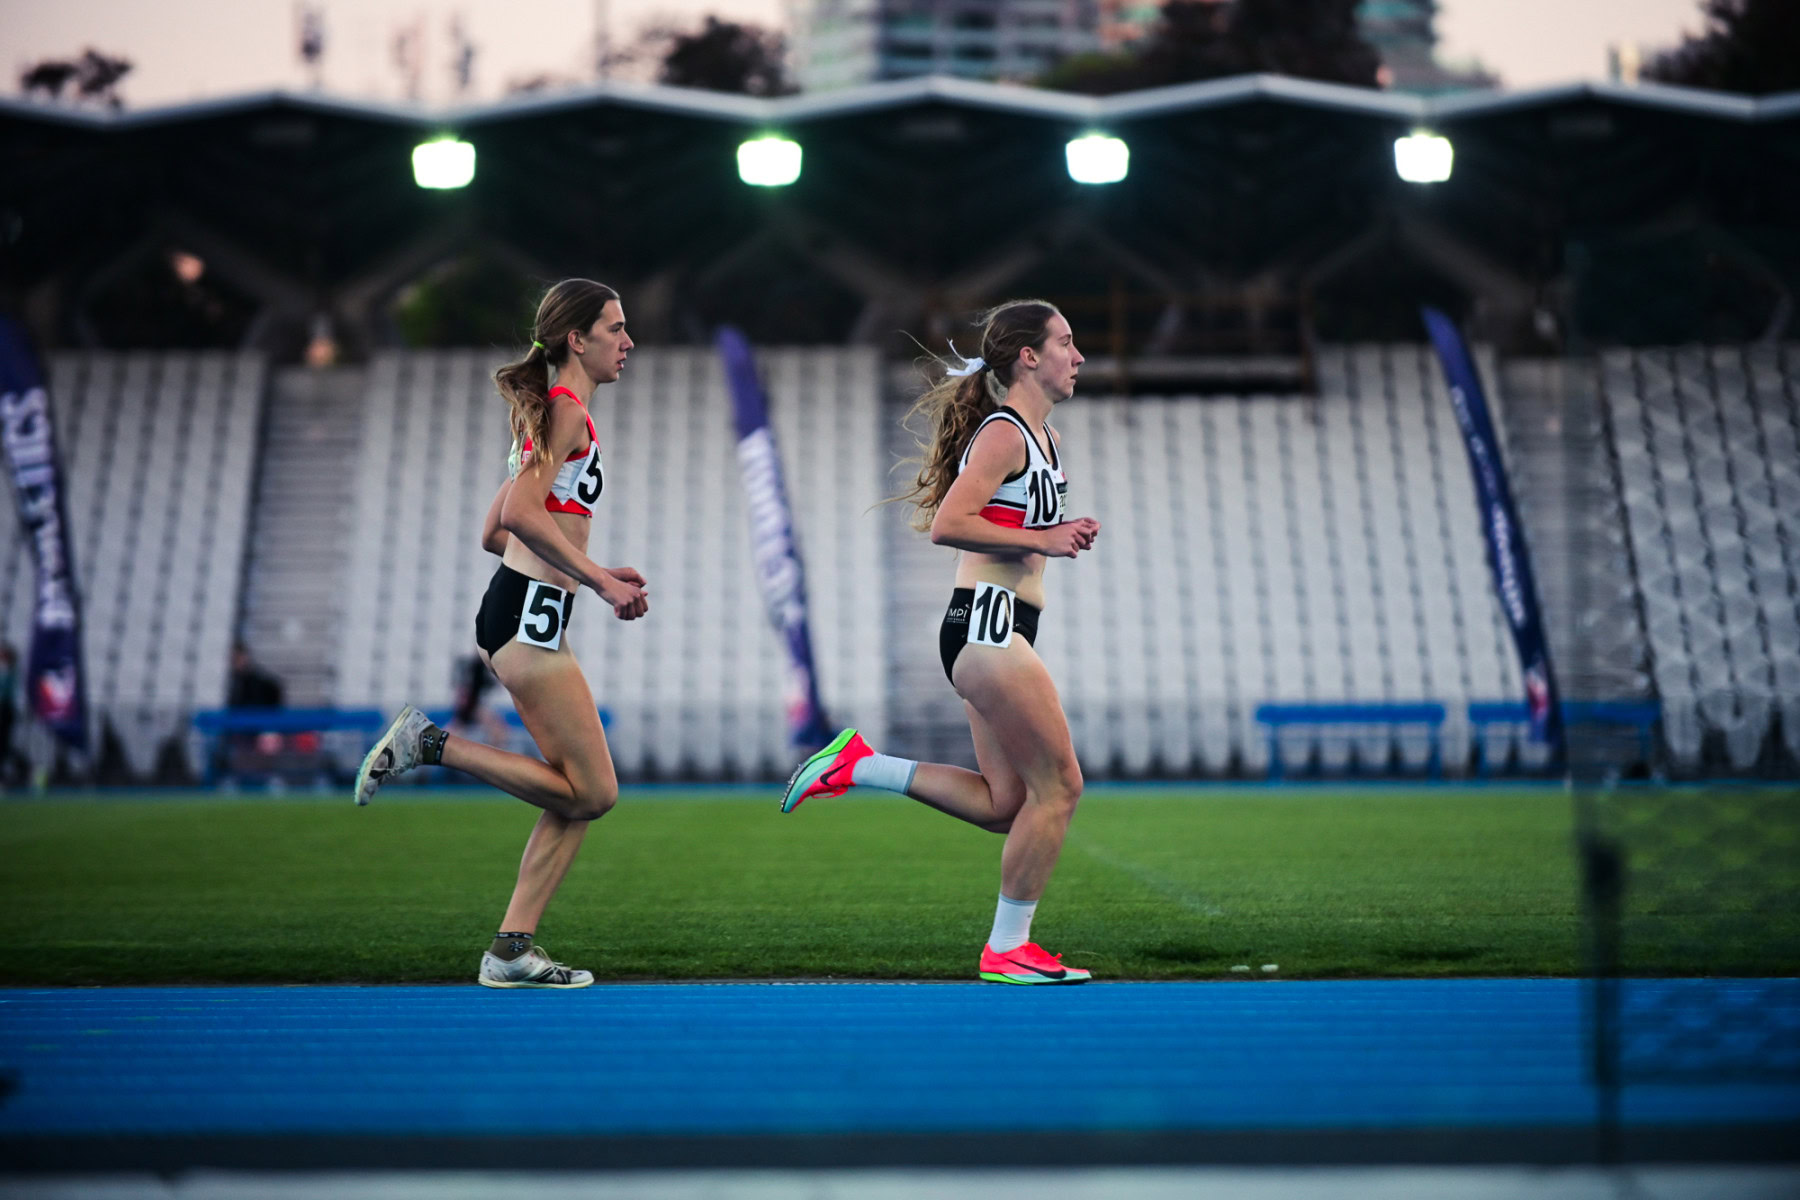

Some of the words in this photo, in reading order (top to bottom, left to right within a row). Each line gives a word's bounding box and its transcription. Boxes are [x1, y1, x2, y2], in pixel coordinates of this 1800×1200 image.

[578, 447, 603, 504] 5
[1029, 469, 1057, 524] 10
[525, 584, 562, 642] 5
[975, 586, 1011, 643] 10
